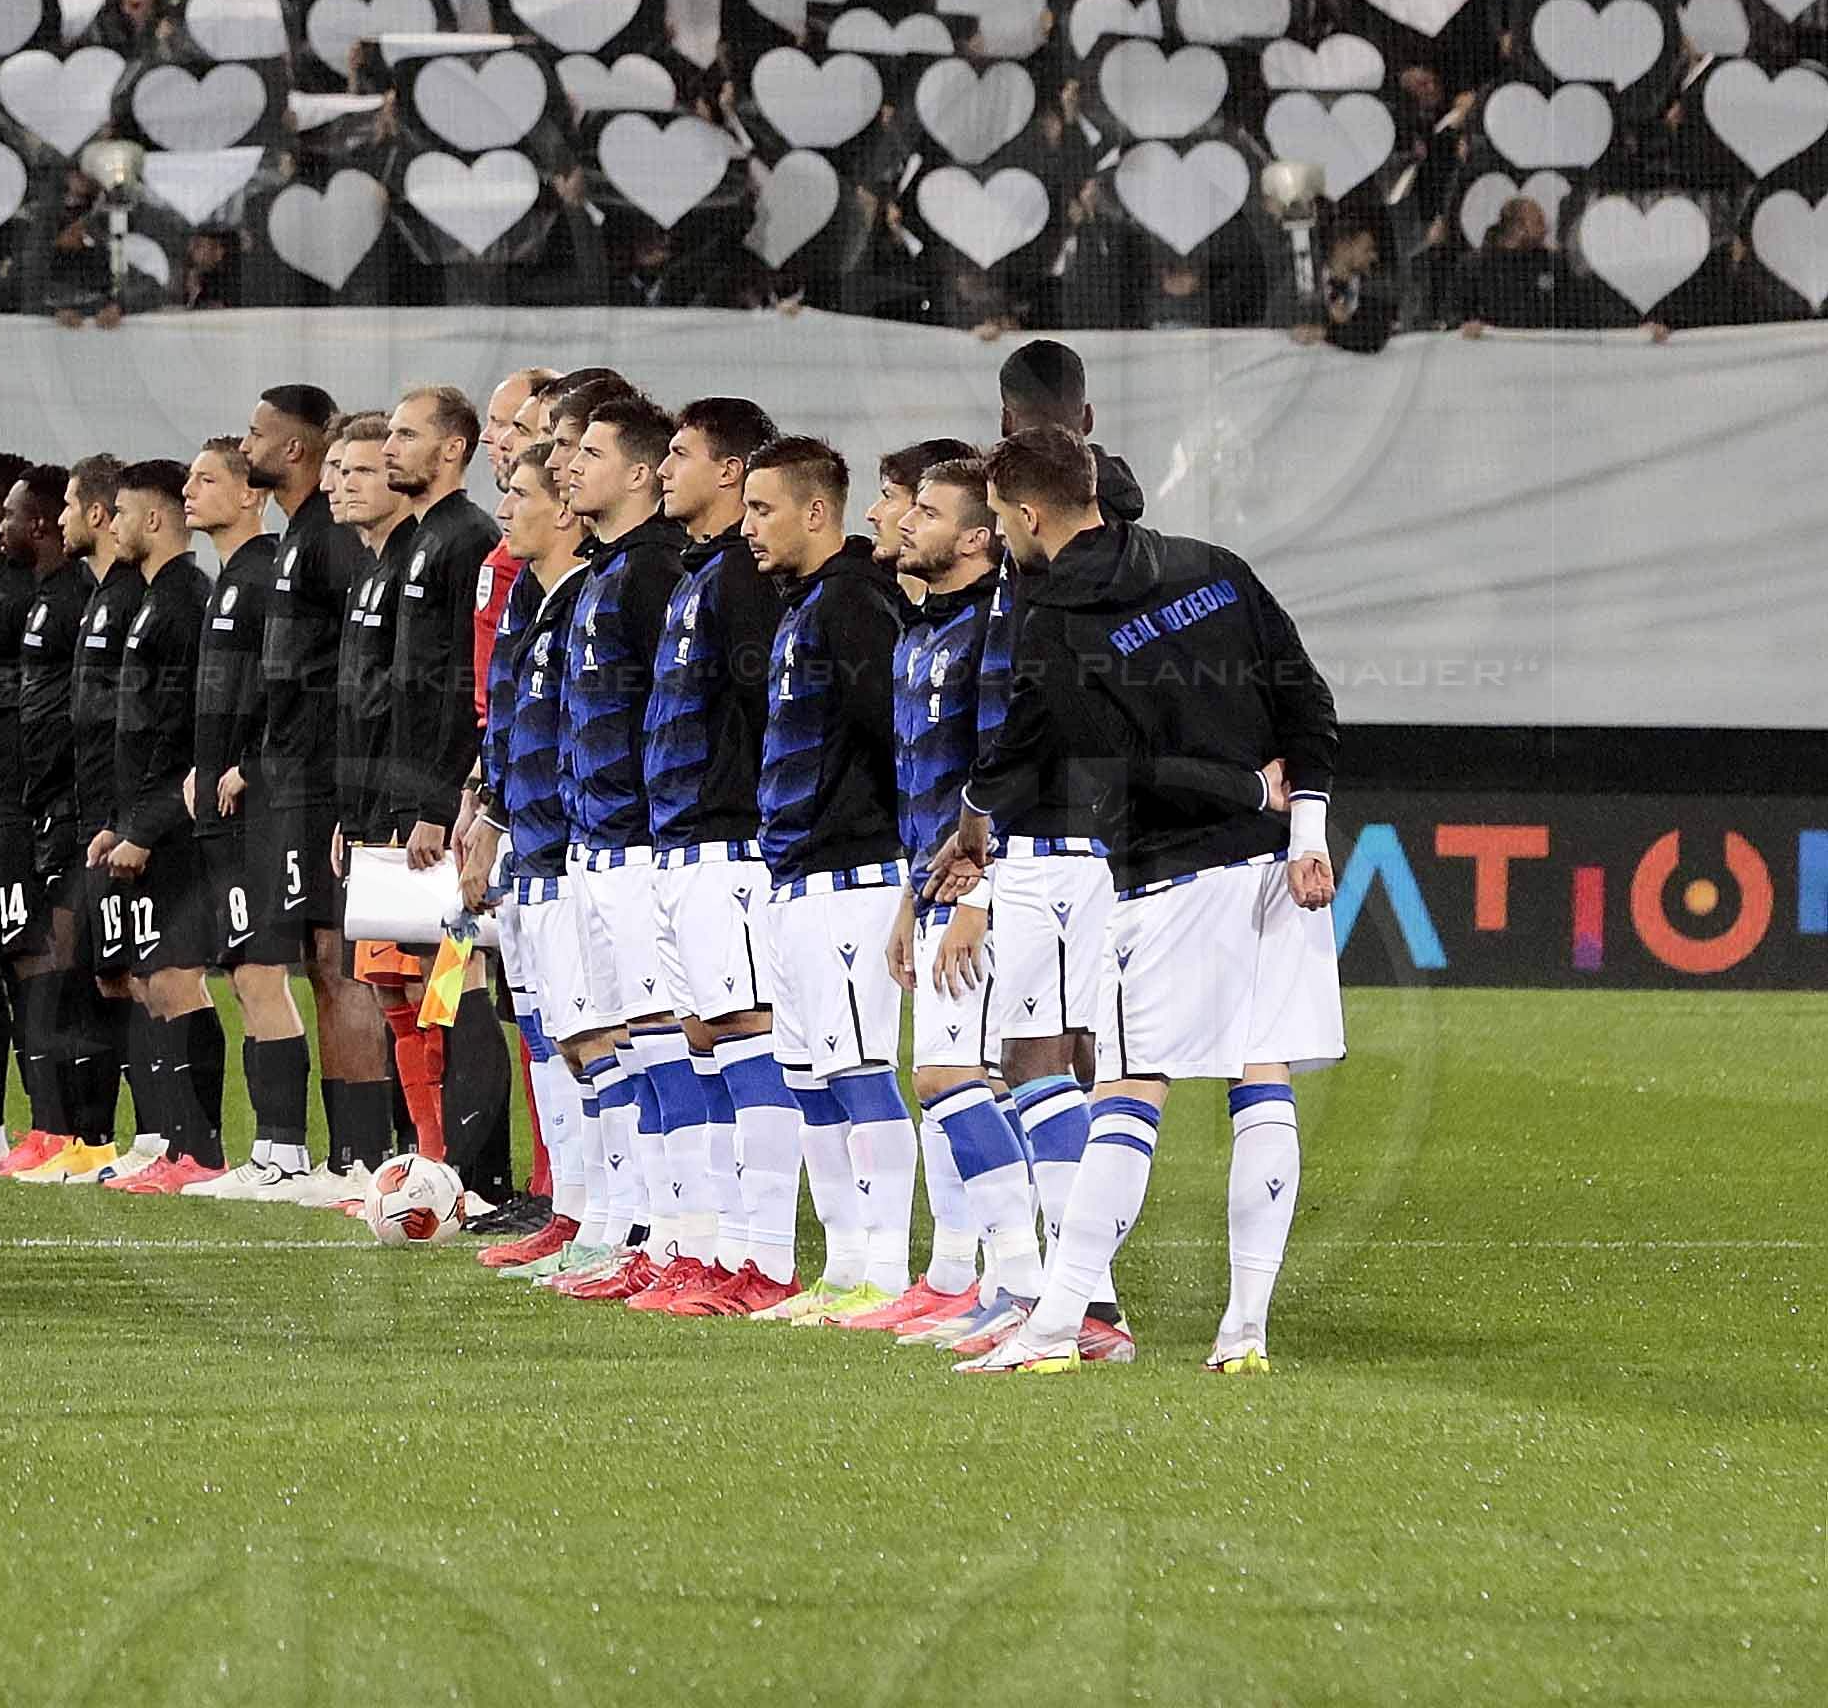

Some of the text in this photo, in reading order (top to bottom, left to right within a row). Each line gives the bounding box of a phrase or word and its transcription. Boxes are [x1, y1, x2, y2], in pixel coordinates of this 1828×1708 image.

[1108, 613, 1161, 657] REAL
[286, 849, 302, 895] 5
[0, 882, 28, 929] 14
[228, 886, 249, 932] 8
